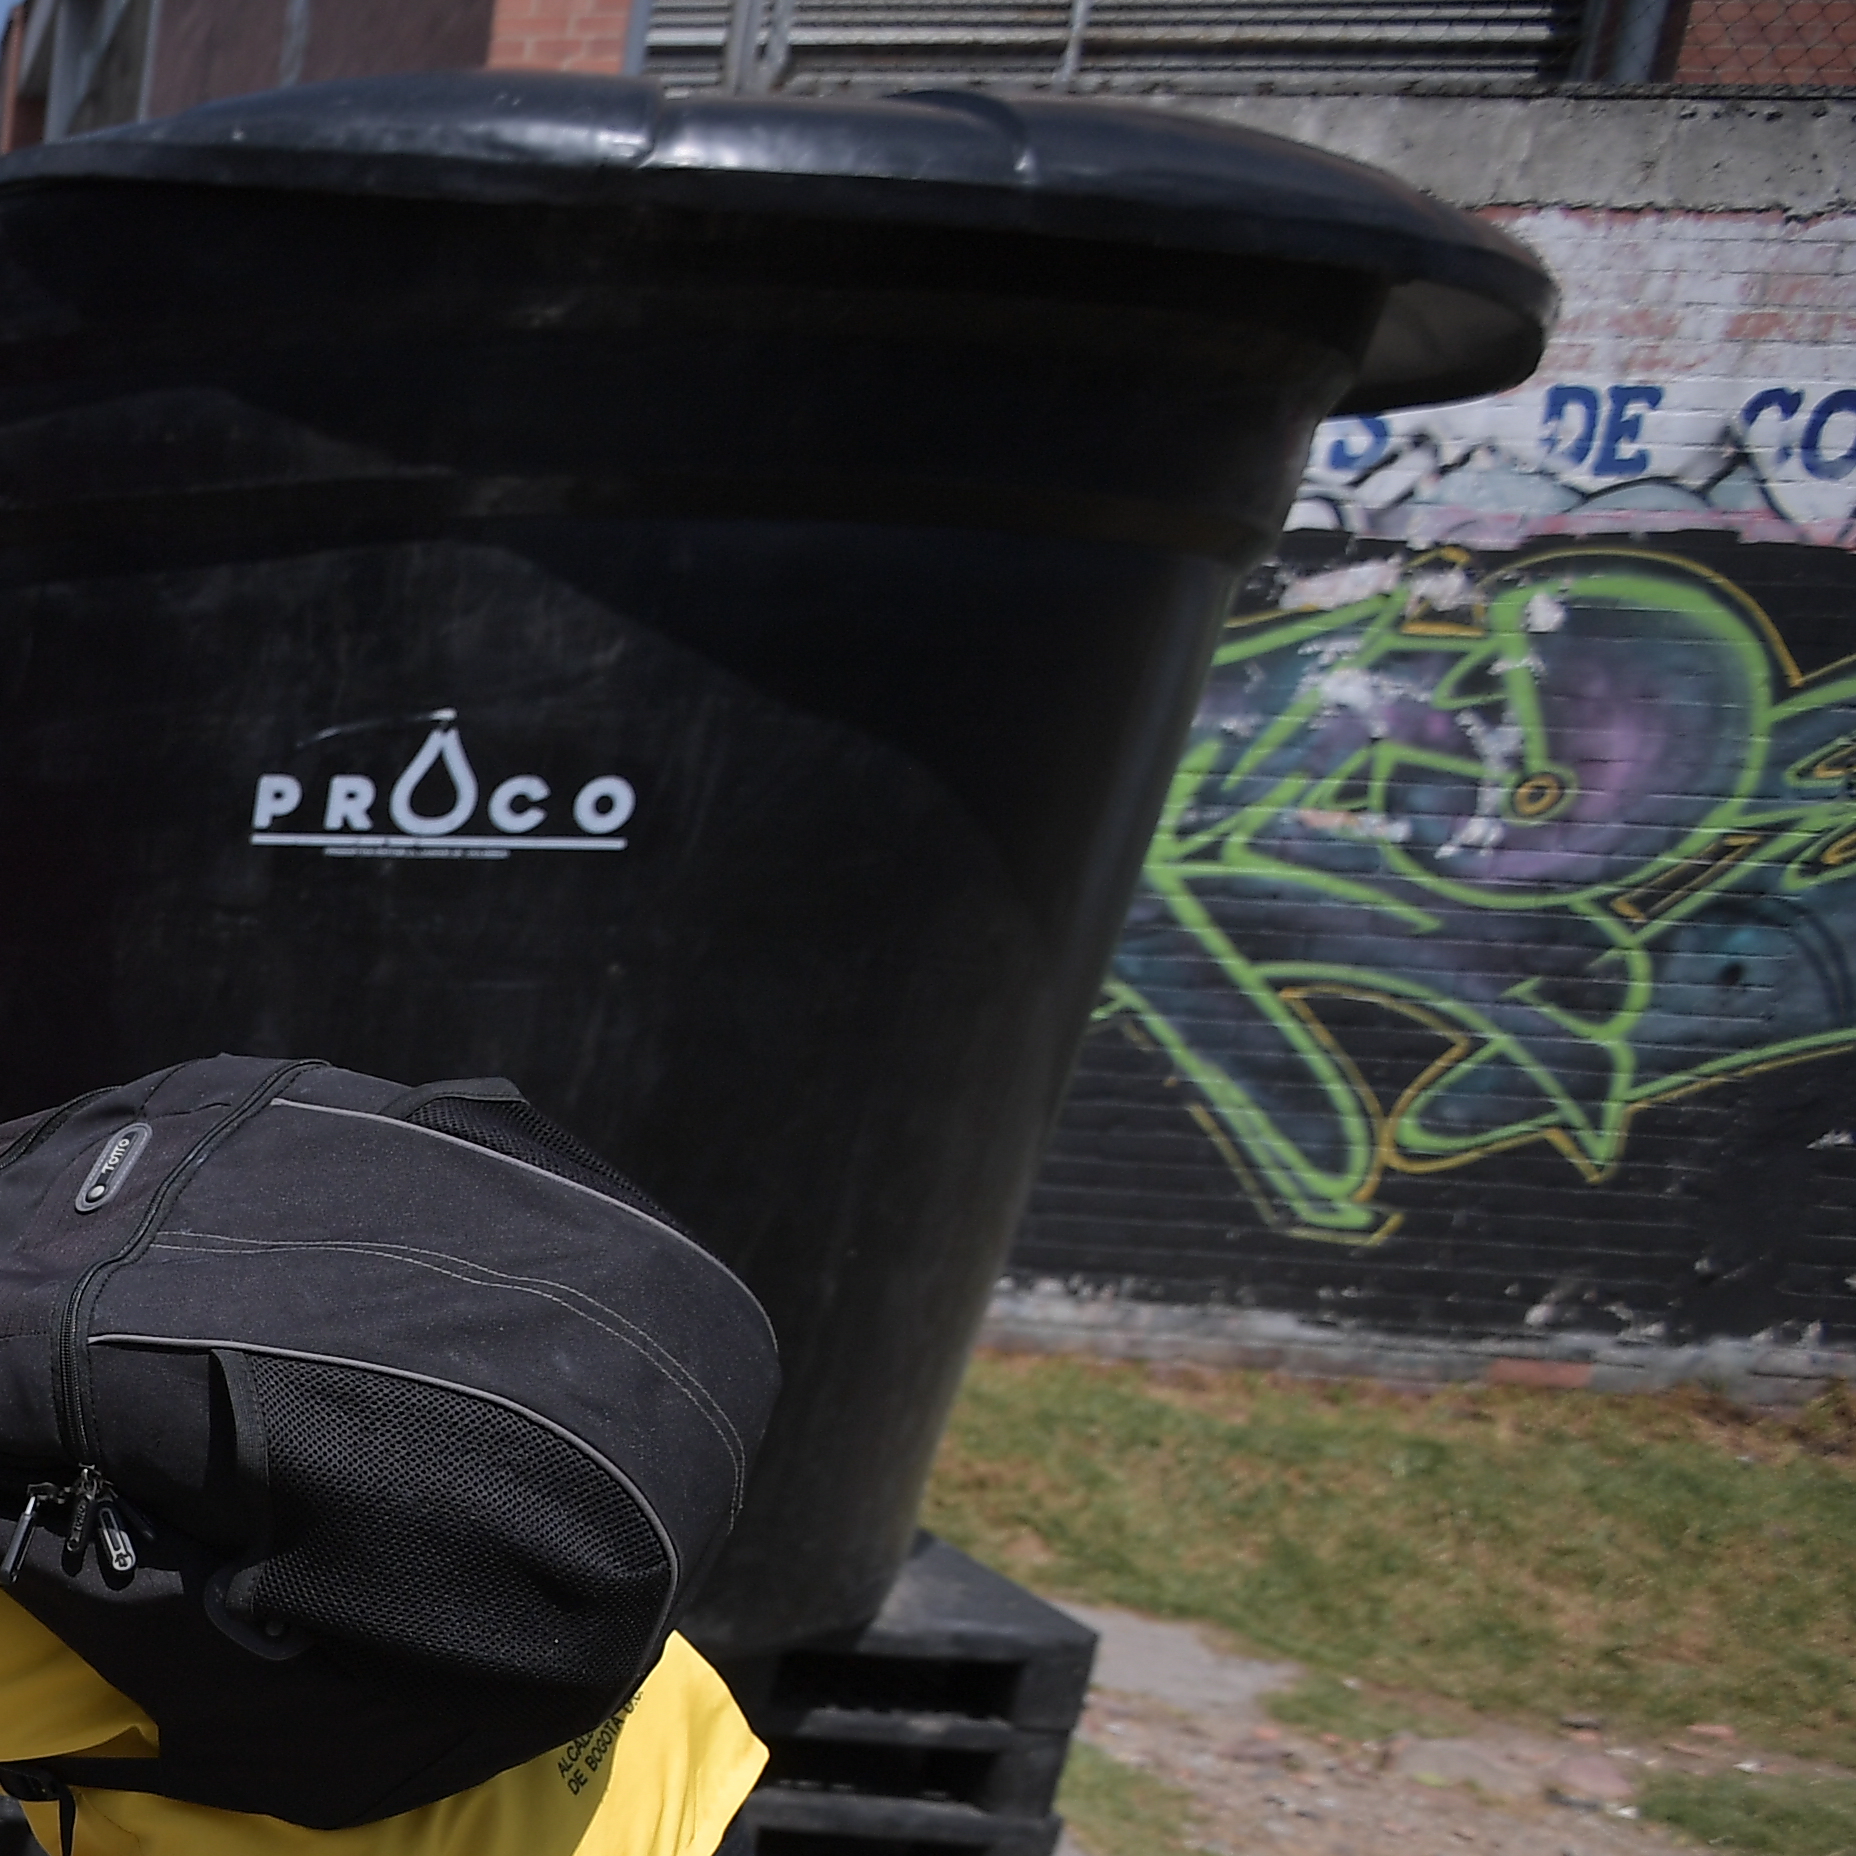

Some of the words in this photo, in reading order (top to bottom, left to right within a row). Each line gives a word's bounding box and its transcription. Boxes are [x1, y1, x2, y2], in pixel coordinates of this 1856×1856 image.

[1542, 384, 1664, 477] DE
[101, 1138, 130, 1174] TOTTO
[567, 1768, 588, 1796] DE
